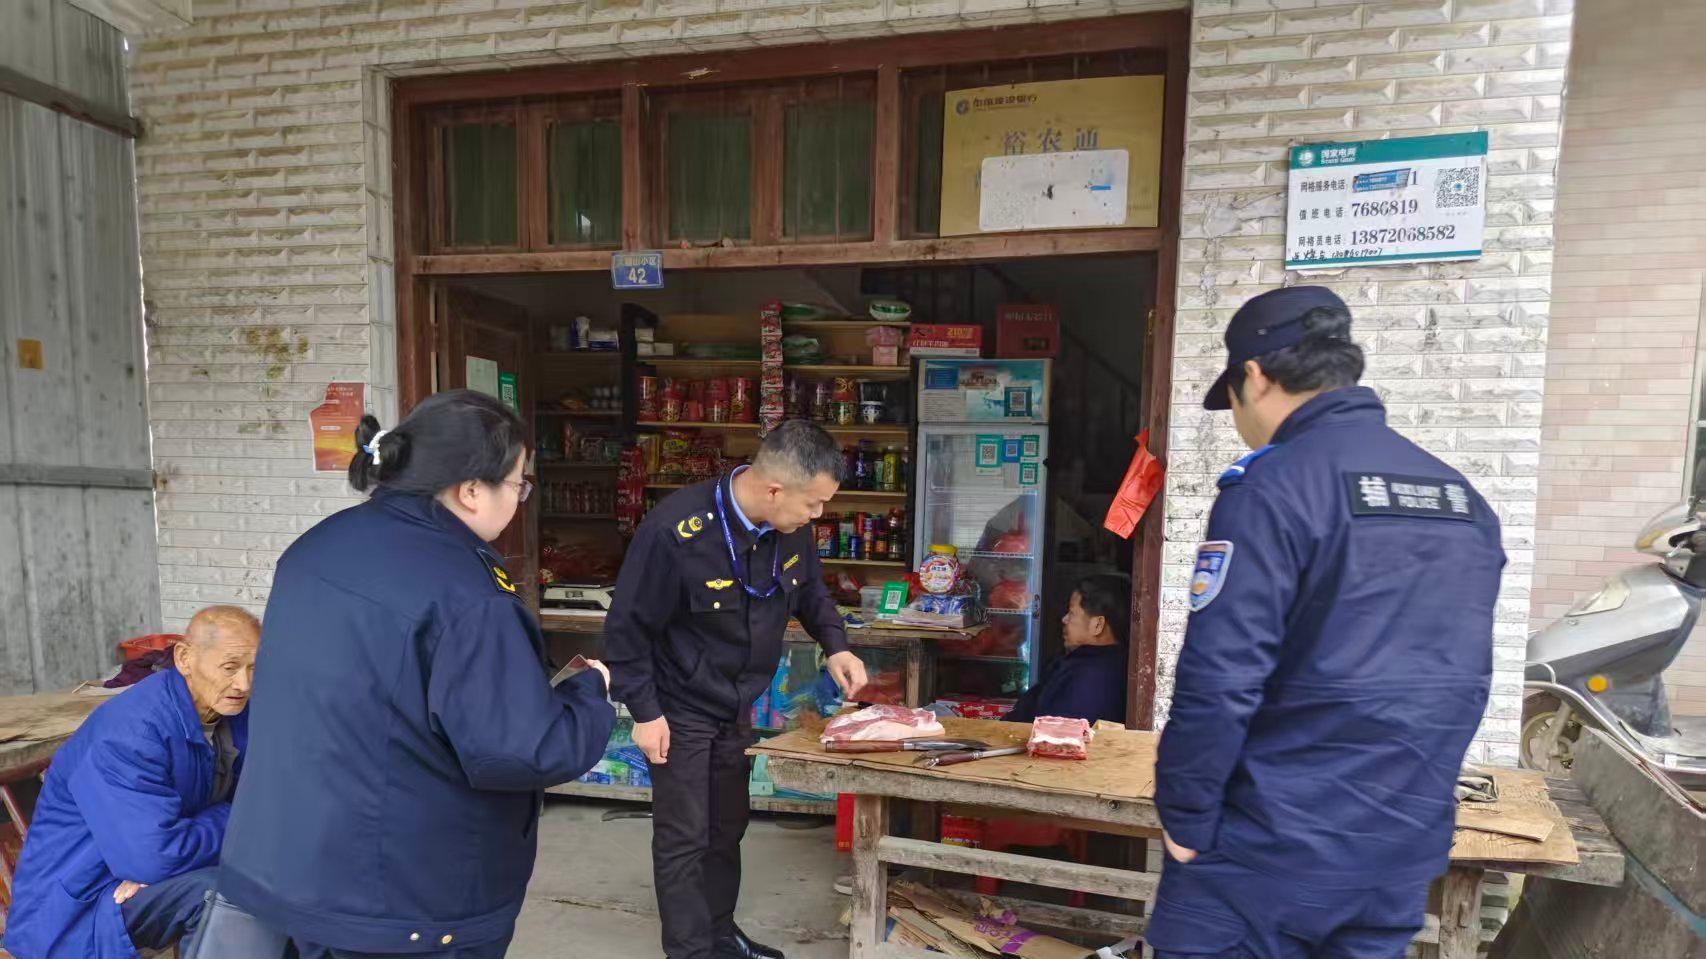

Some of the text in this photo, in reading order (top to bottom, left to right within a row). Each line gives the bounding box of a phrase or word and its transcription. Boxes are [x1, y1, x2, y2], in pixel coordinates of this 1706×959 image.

[1299, 199, 1418, 221] 值班电话 7686819
[1298, 225, 1455, 247] 网格员电话 13872068582
[629, 267, 647, 284] 42
